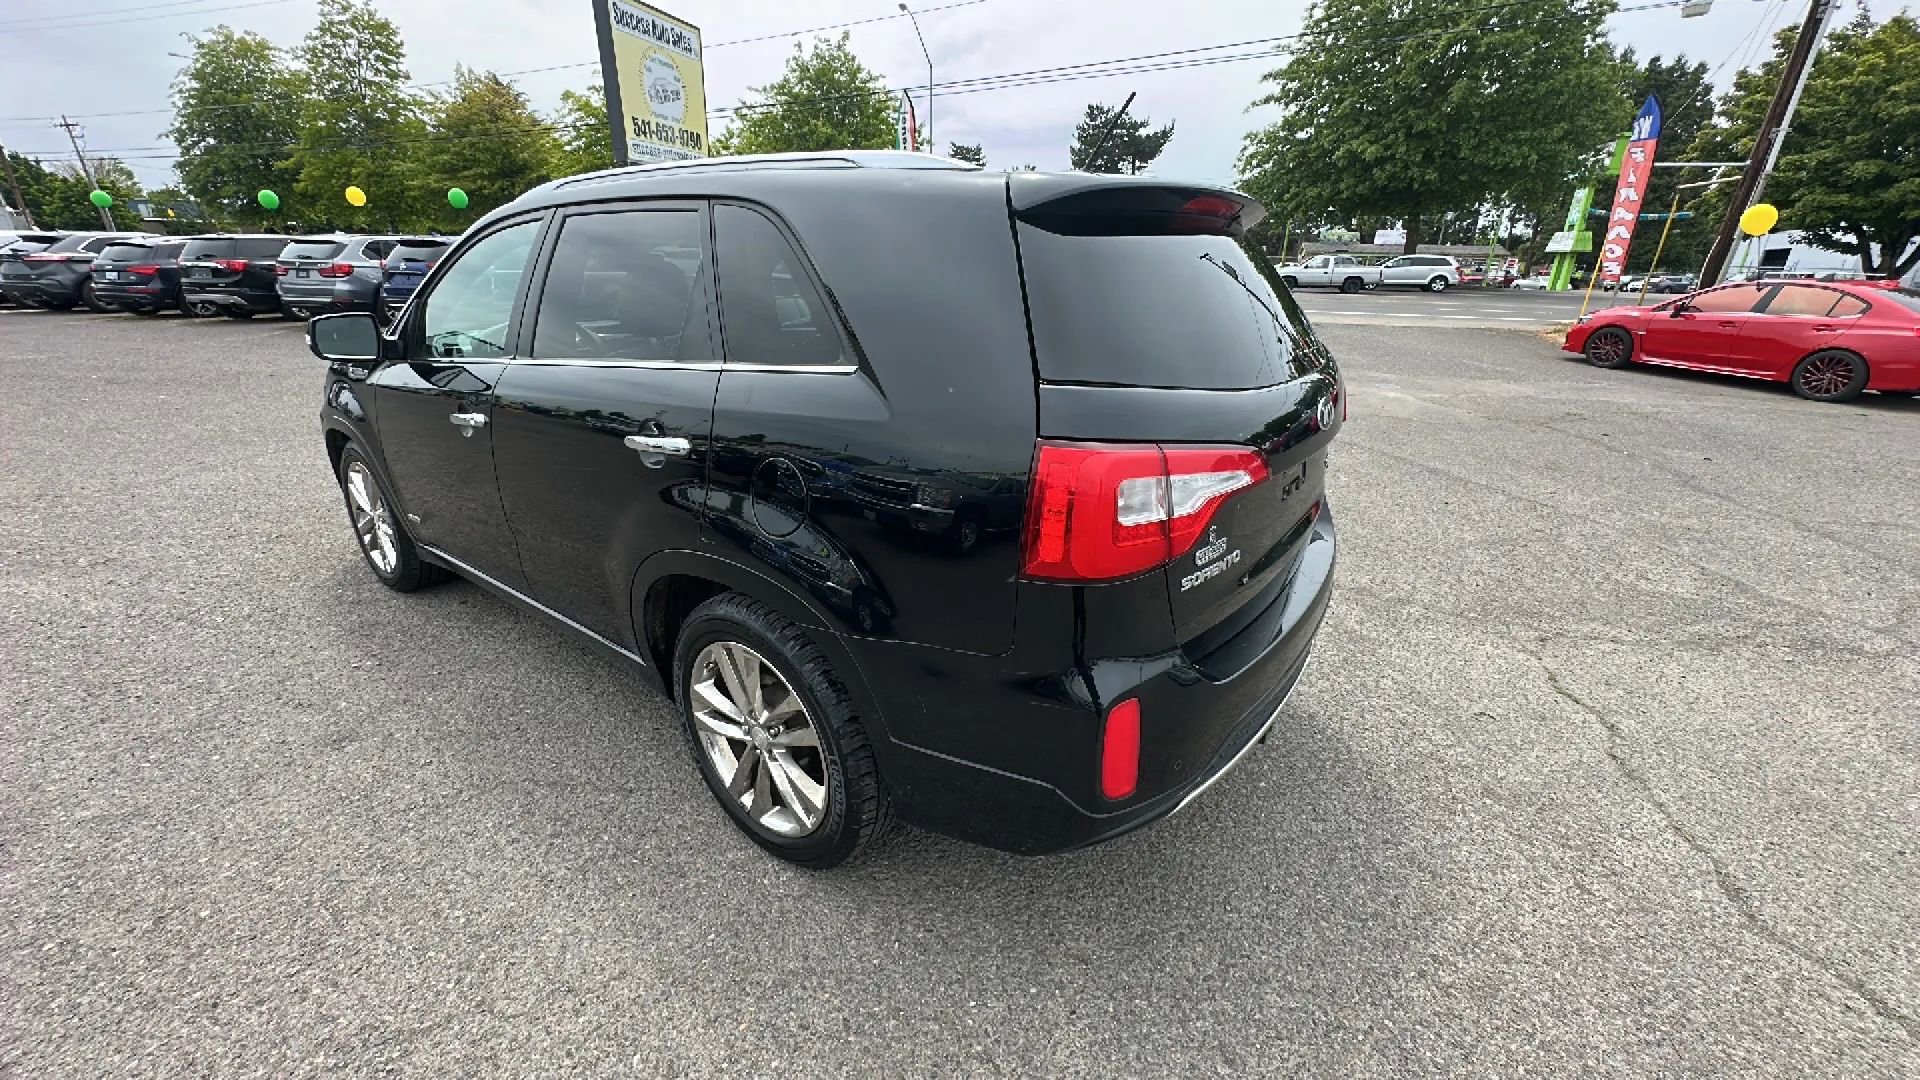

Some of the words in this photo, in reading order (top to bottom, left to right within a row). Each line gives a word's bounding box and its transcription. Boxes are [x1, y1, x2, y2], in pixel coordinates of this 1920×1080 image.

[612, 2, 651, 36] Success
[652, 18, 670, 45] Auto
[671, 27, 692, 54] Sales
[632, 116, 702, 150] 541-653-9790
[1181, 549, 1241, 592] SORENTO
